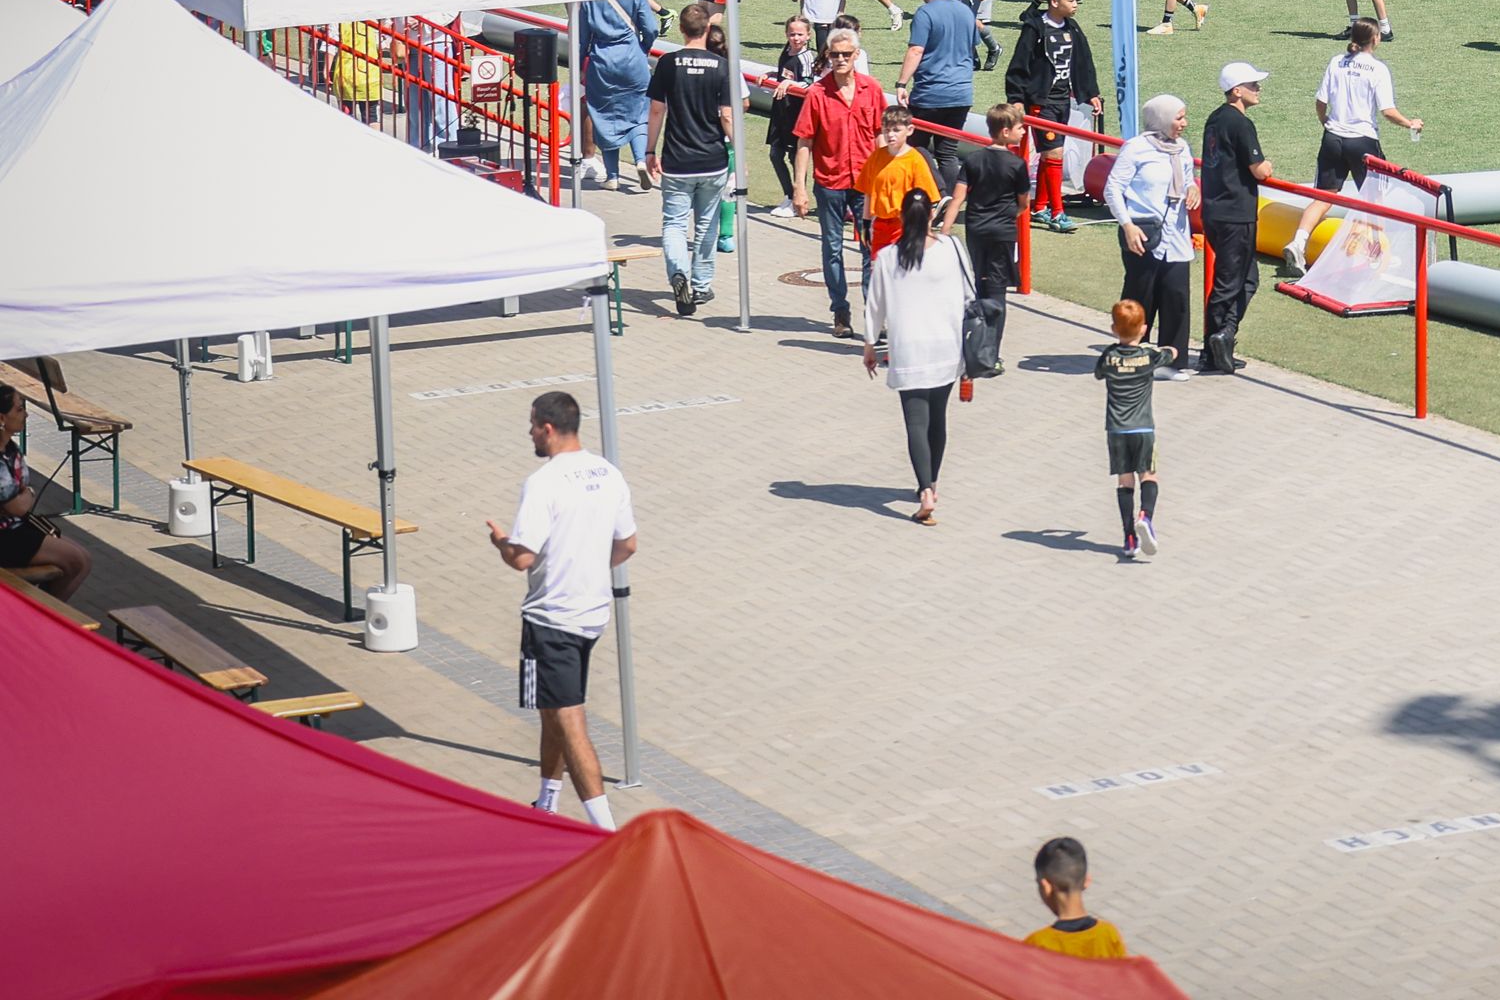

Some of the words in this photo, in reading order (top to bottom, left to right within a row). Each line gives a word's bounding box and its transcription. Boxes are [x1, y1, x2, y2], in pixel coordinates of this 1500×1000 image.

[682, 57, 693, 66] FC
[693, 58, 719, 69] UNION
[1353, 61, 1375, 72] UNION
